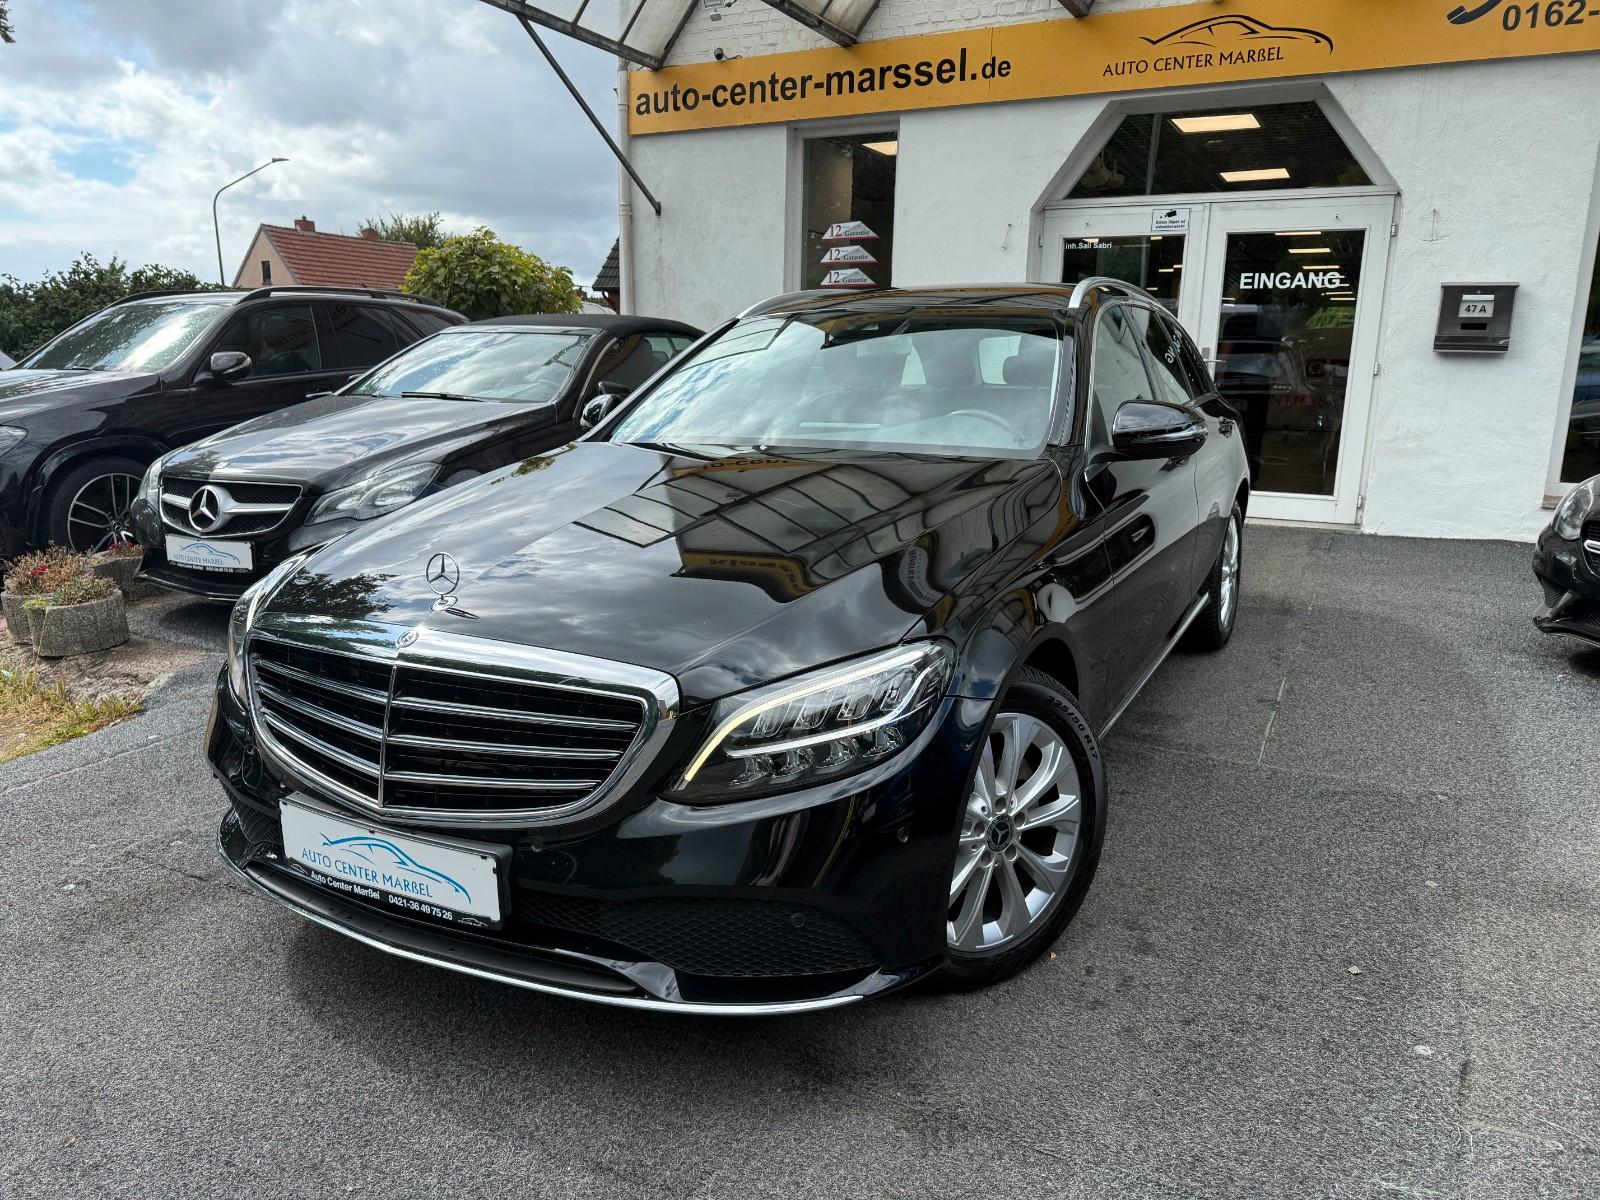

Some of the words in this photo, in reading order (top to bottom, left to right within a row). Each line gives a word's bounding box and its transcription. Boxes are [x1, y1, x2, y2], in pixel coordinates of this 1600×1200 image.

[1102, 60, 1149, 77] AUTO
[1153, 53, 1213, 72] CENTER
[635, 47, 1012, 116] auto-center-marssel.de
[830, 225, 841, 236] 12
[829, 248, 841, 261] 12
[1093, 241, 1113, 249] Sabri
[828, 271, 840, 284] 12
[1239, 271, 1341, 290] EINGANG
[1048, 695, 1086, 732] 225/50
[1083, 734, 1099, 760] R17
[301, 847, 331, 868] AUTO
[334, 860, 379, 884] CENTER
[382, 873, 433, 898] MARßEL
[310, 870, 326, 883] Auto
[327, 877, 353, 892] Center
[388, 894, 420, 911] 0421-36
[420, 904, 431, 915] 49
[431, 906, 442, 918] 75
[442, 910, 453, 921] 26
